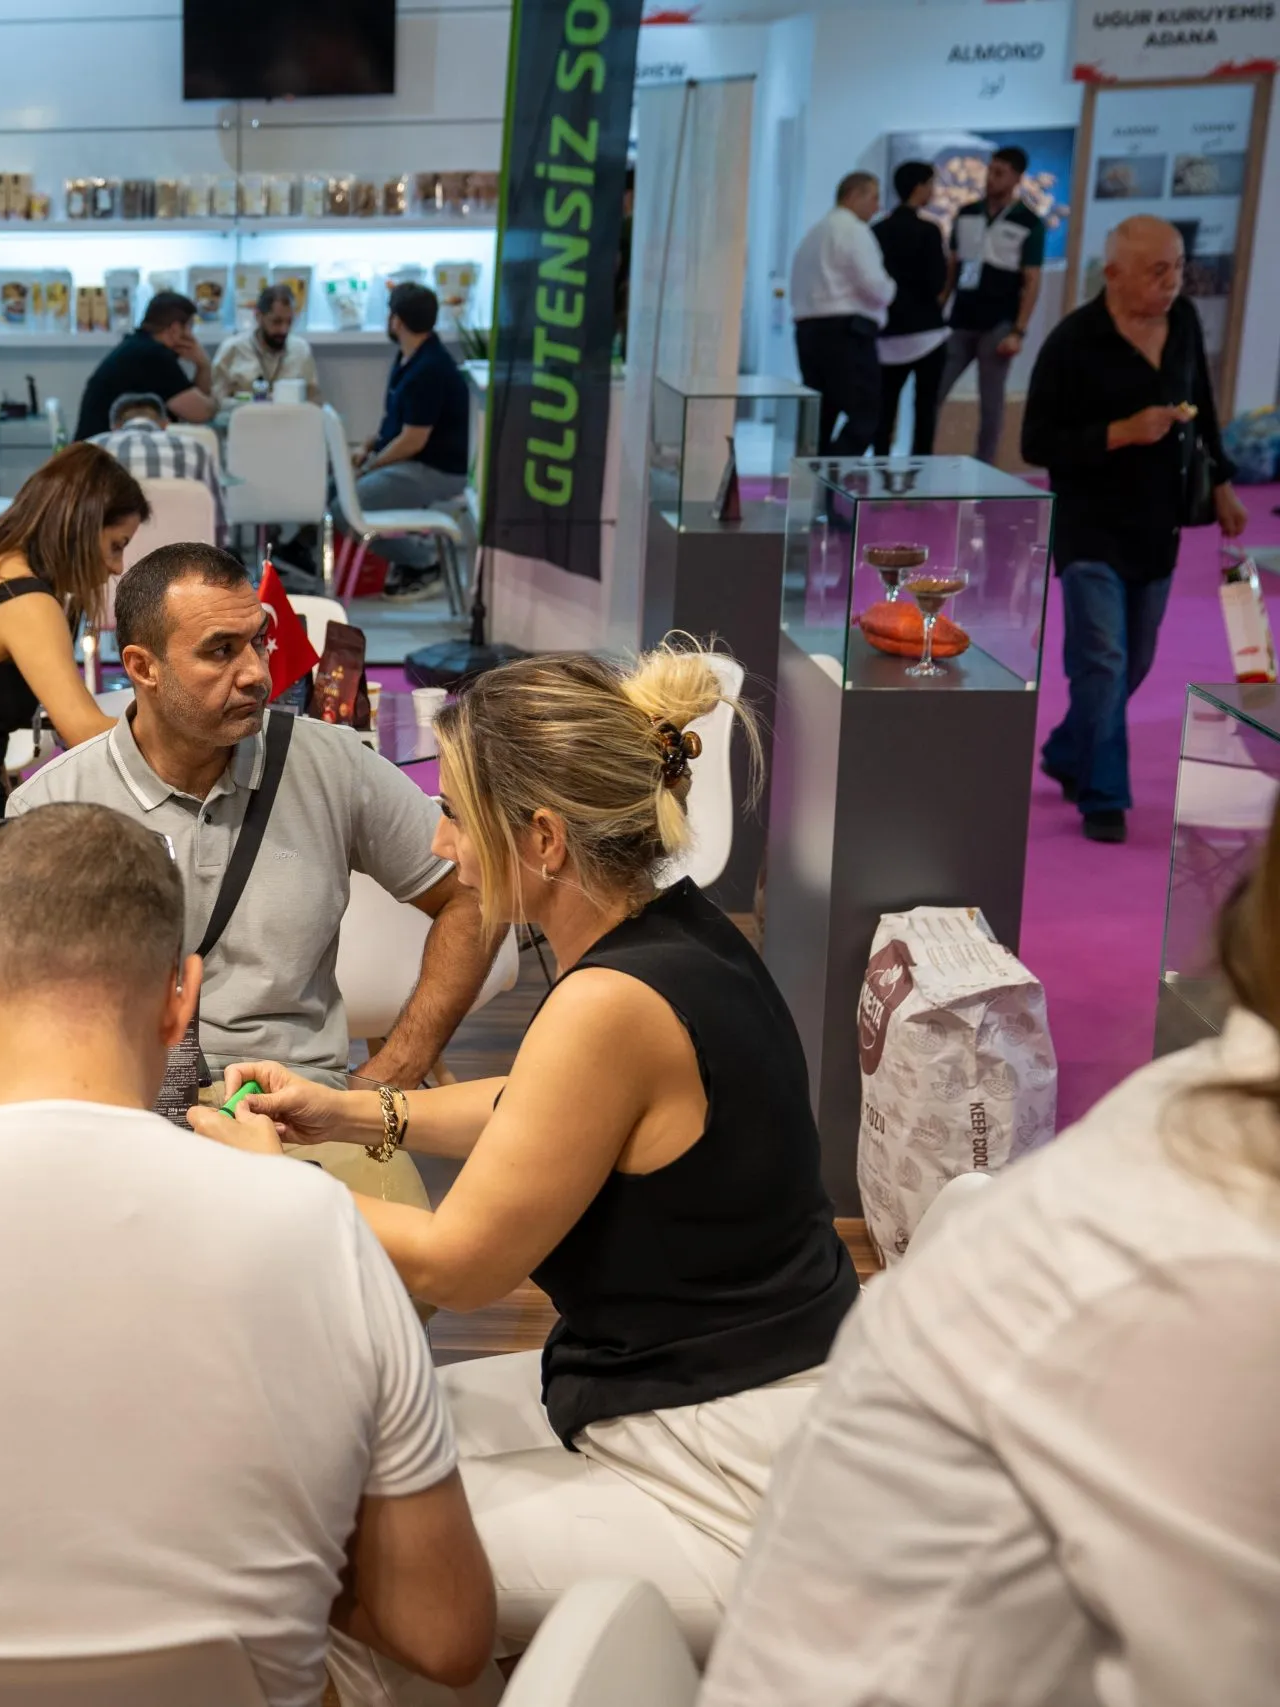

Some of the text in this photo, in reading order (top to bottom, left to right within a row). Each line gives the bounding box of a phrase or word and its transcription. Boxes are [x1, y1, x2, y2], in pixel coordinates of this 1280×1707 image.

[946, 42, 1045, 66] ALMOND
[1144, 29, 1218, 48] ADANA
[524, 115, 599, 507] GLUTENSİZ
[866, 1102, 885, 1135] TOZU
[969, 1102, 988, 1169] KEEP COOL
